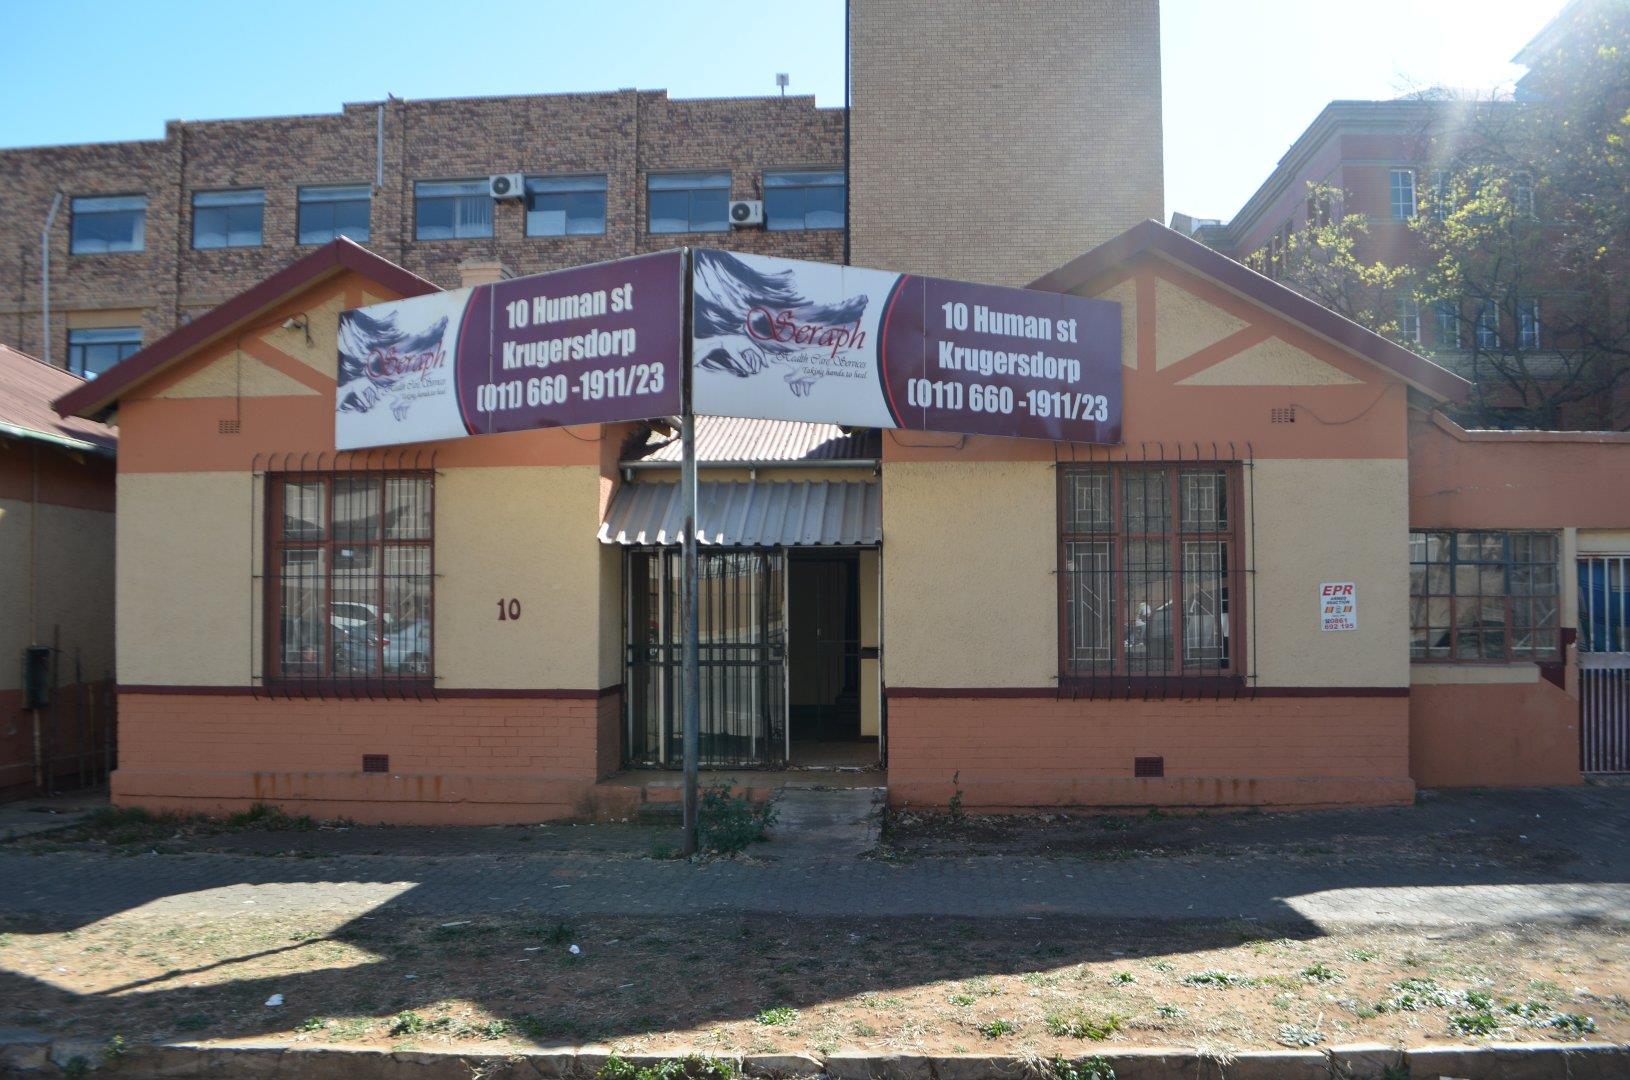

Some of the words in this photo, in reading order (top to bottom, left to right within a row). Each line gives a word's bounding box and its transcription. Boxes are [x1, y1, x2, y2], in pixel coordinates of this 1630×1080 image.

[506, 299, 527, 329] 10
[533, 290, 606, 325] Human
[611, 283, 634, 312] st
[942, 302, 968, 331] 10
[974, 305, 1051, 341] Human
[1057, 318, 1078, 343] st
[503, 328, 636, 370] Krugersdorp
[747, 305, 866, 358] Seraph
[833, 355, 867, 369] Services
[938, 341, 1081, 384] Krugersdorp
[477, 381, 522, 413] (011)
[527, 374, 567, 407] 660
[572, 362, 664, 401] -1911/23
[908, 378, 963, 411] (011)
[969, 384, 1013, 415] 660
[1019, 387, 1109, 423] -1911/23
[497, 598, 521, 621] 10
[1322, 585, 1353, 596] EPR
